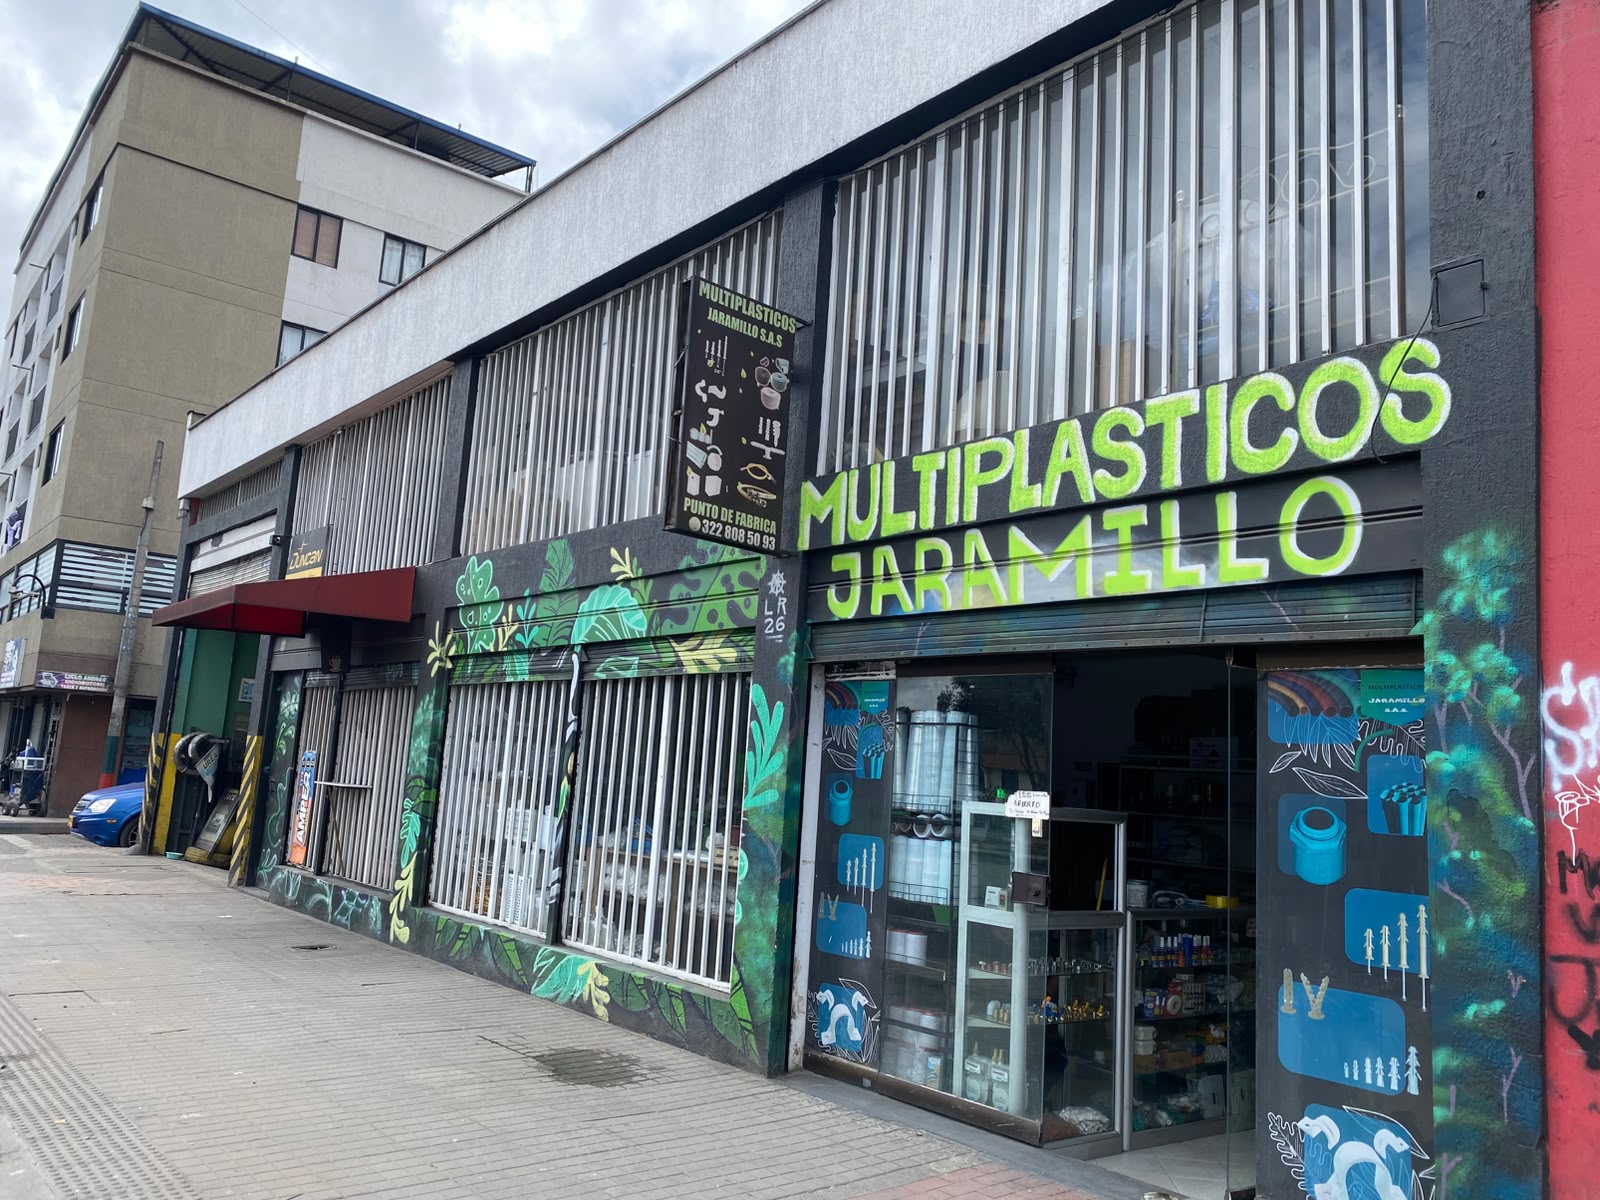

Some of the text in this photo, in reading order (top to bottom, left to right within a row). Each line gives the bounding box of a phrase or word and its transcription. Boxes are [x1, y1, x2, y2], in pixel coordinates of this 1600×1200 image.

[698, 280, 796, 334] MULTIPLASTICOS
[707, 306, 783, 348] JARAMILLO S.A.S
[798, 336, 1452, 550] MULTIPLASTICOS
[683, 496, 777, 535] PUNTO DE FABRICA
[702, 519, 776, 551] 322 808 50 93
[827, 474, 1364, 619] JARAMILLO
[764, 616, 785, 634] 26
